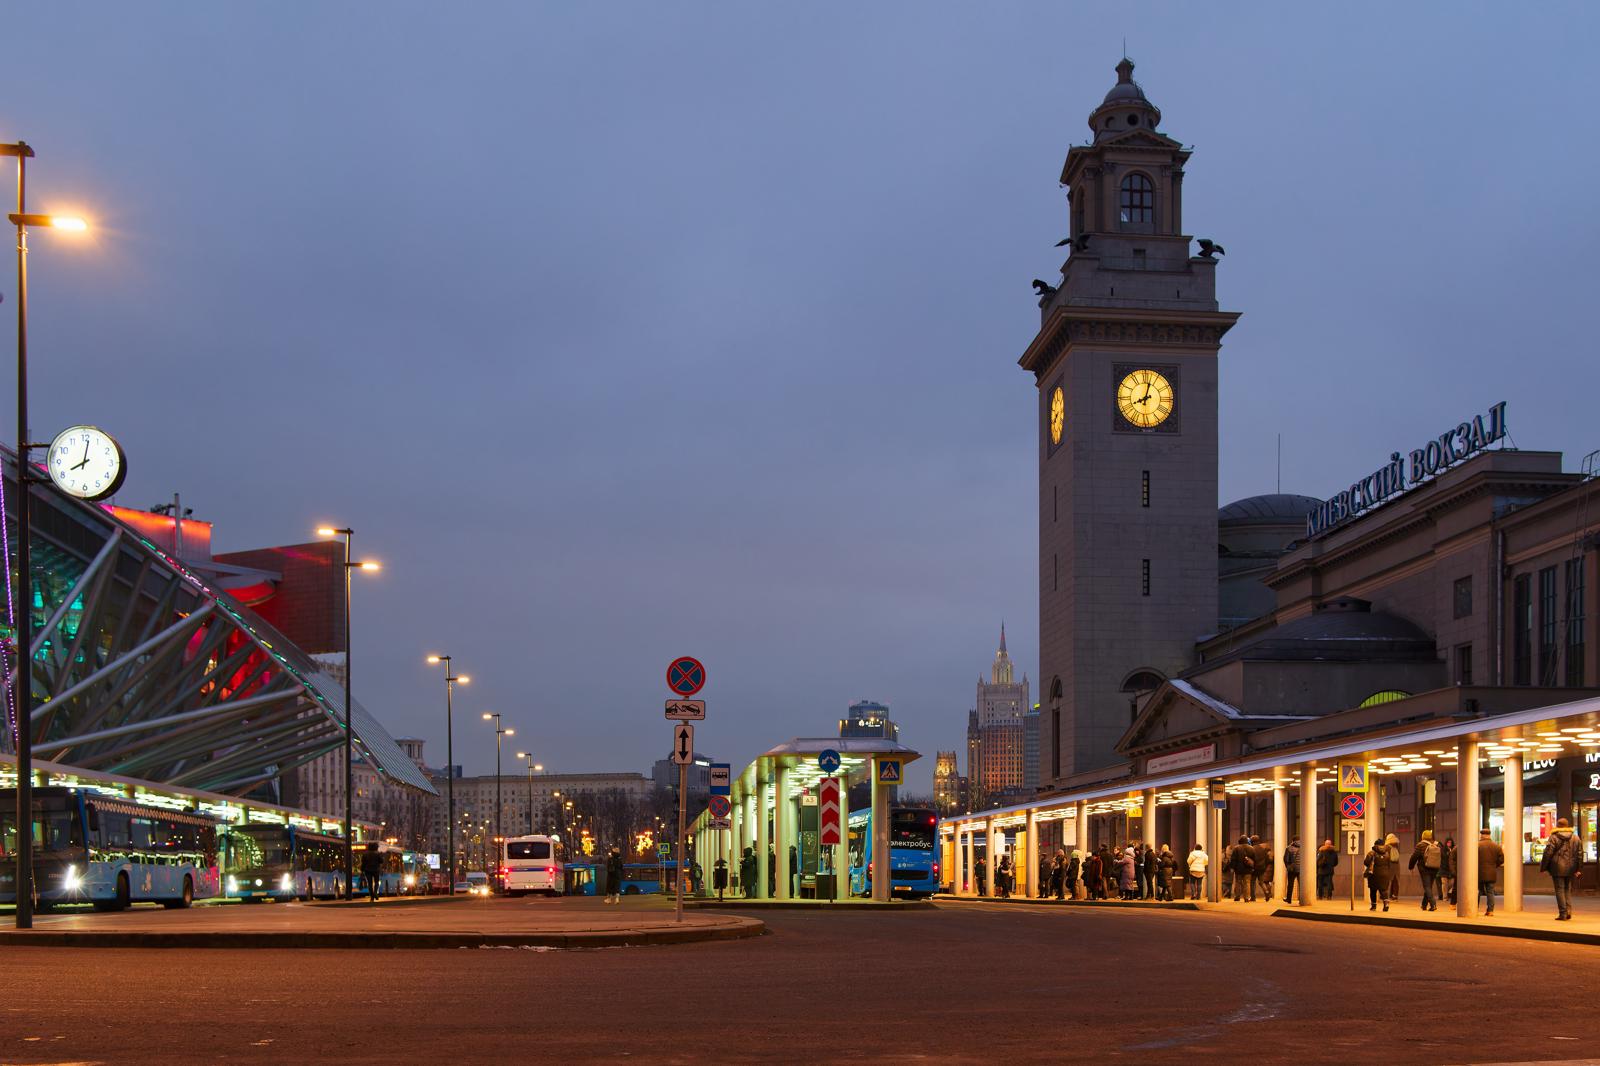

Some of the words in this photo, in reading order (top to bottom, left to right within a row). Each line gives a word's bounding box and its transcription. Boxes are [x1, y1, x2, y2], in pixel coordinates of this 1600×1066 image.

[81, 434, 90, 442] 12
[105, 447, 110, 455] 2
[1306, 452, 1405, 538] КИЕВСКИЙ
[1409, 401, 1507, 484] ВОКЗАЛ
[60, 471, 65, 479] 8
[82, 483, 88, 491] 6
[96, 480, 101, 488] 5
[891, 840, 933, 849] электробус.
